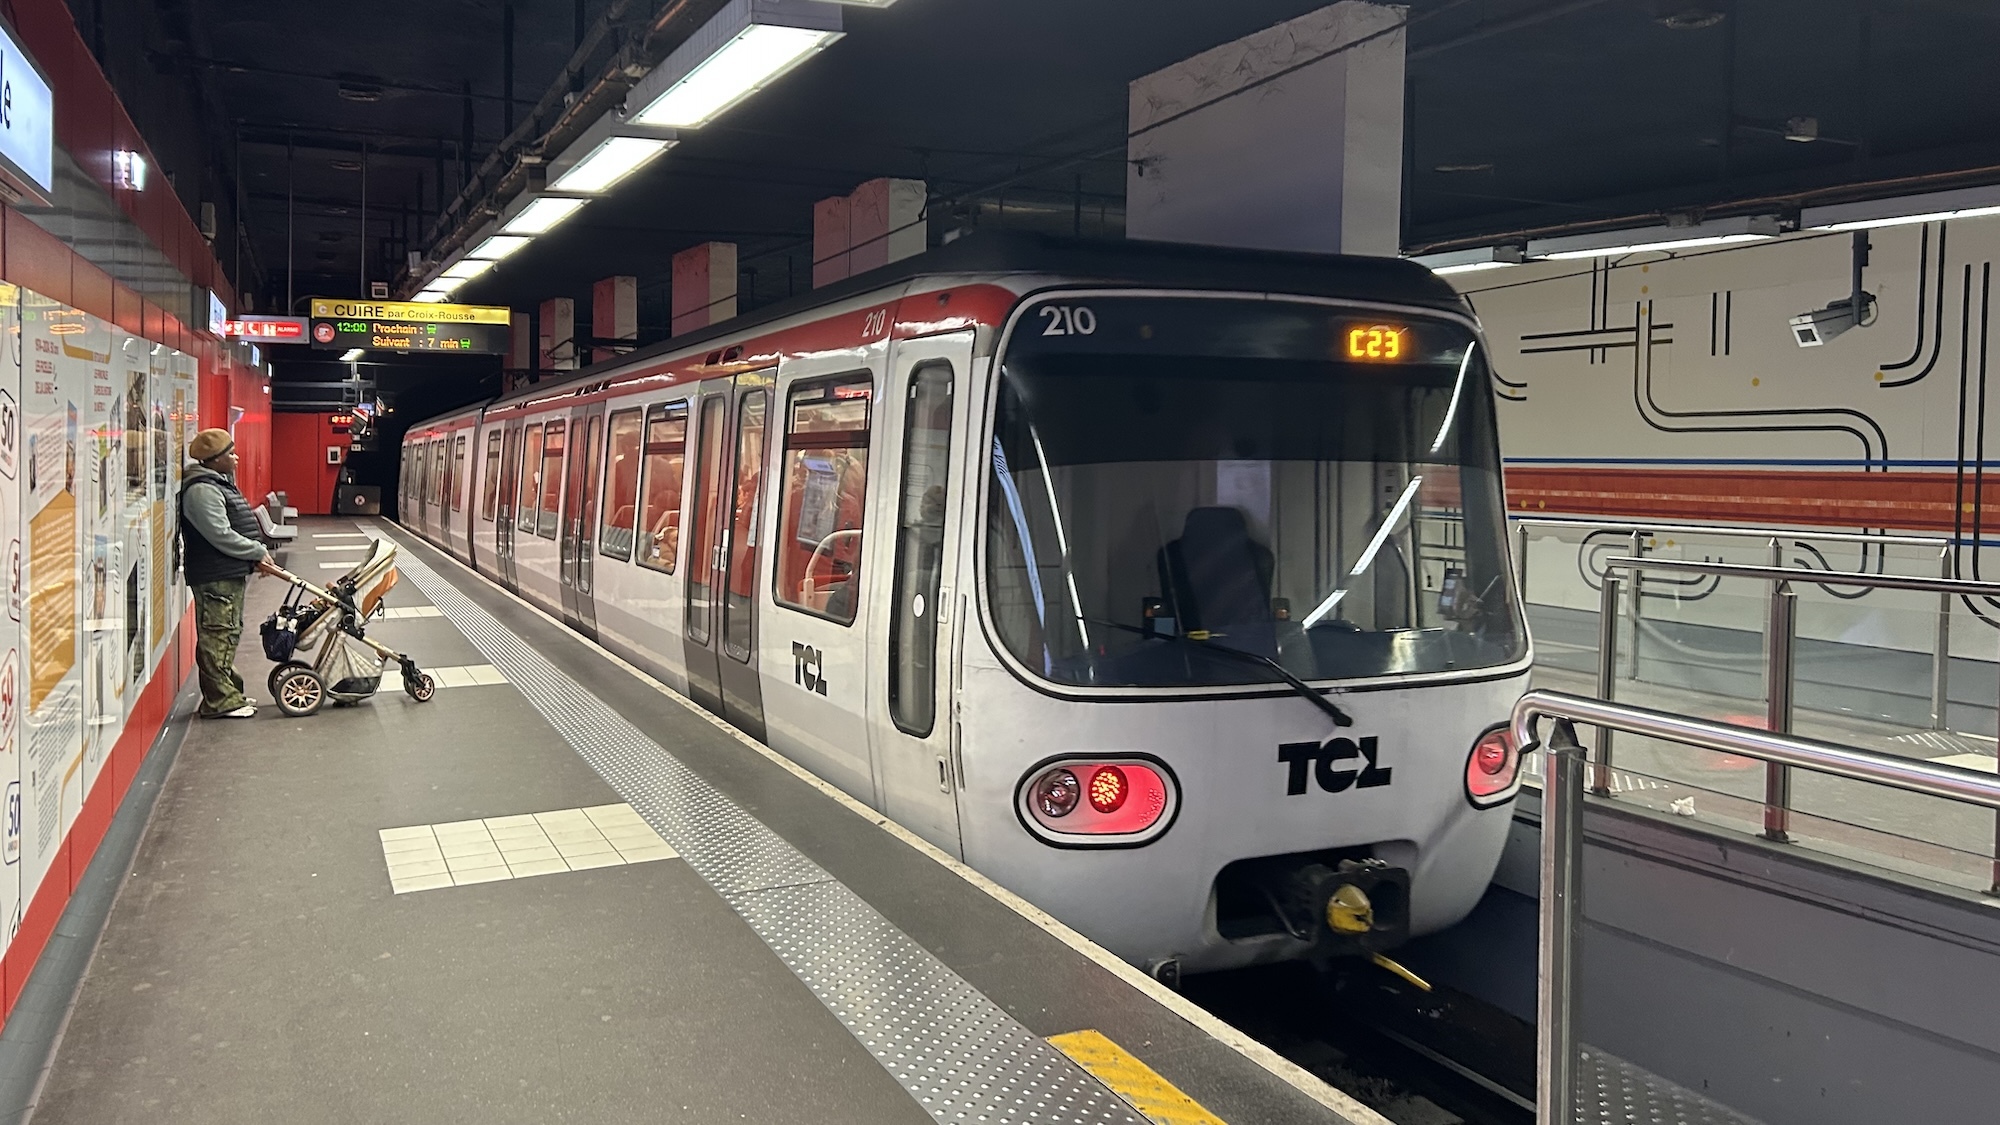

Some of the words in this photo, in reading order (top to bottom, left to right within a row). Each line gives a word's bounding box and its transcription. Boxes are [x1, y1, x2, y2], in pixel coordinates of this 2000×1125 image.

[318, 304, 329, 315] C
[334, 304, 385, 318] CUIRE
[388, 310, 405, 320] par
[408, 309, 476, 321] Croix-Rousse
[862, 308, 886, 338] 210
[1038, 305, 1097, 336] 210
[276, 326, 300, 334] ALARME
[336, 322, 367, 333] 12:00
[372, 322, 417, 335] Prochain
[372, 336, 411, 348] Suivant
[427, 338, 435, 349] 7
[440, 339, 459, 350] min
[1349, 329, 1399, 358] C23
[1, 403, 14, 452] 50
[792, 640, 828, 697] TCL
[1, 664, 14, 722] 50
[1277, 735, 1393, 796] TCL
